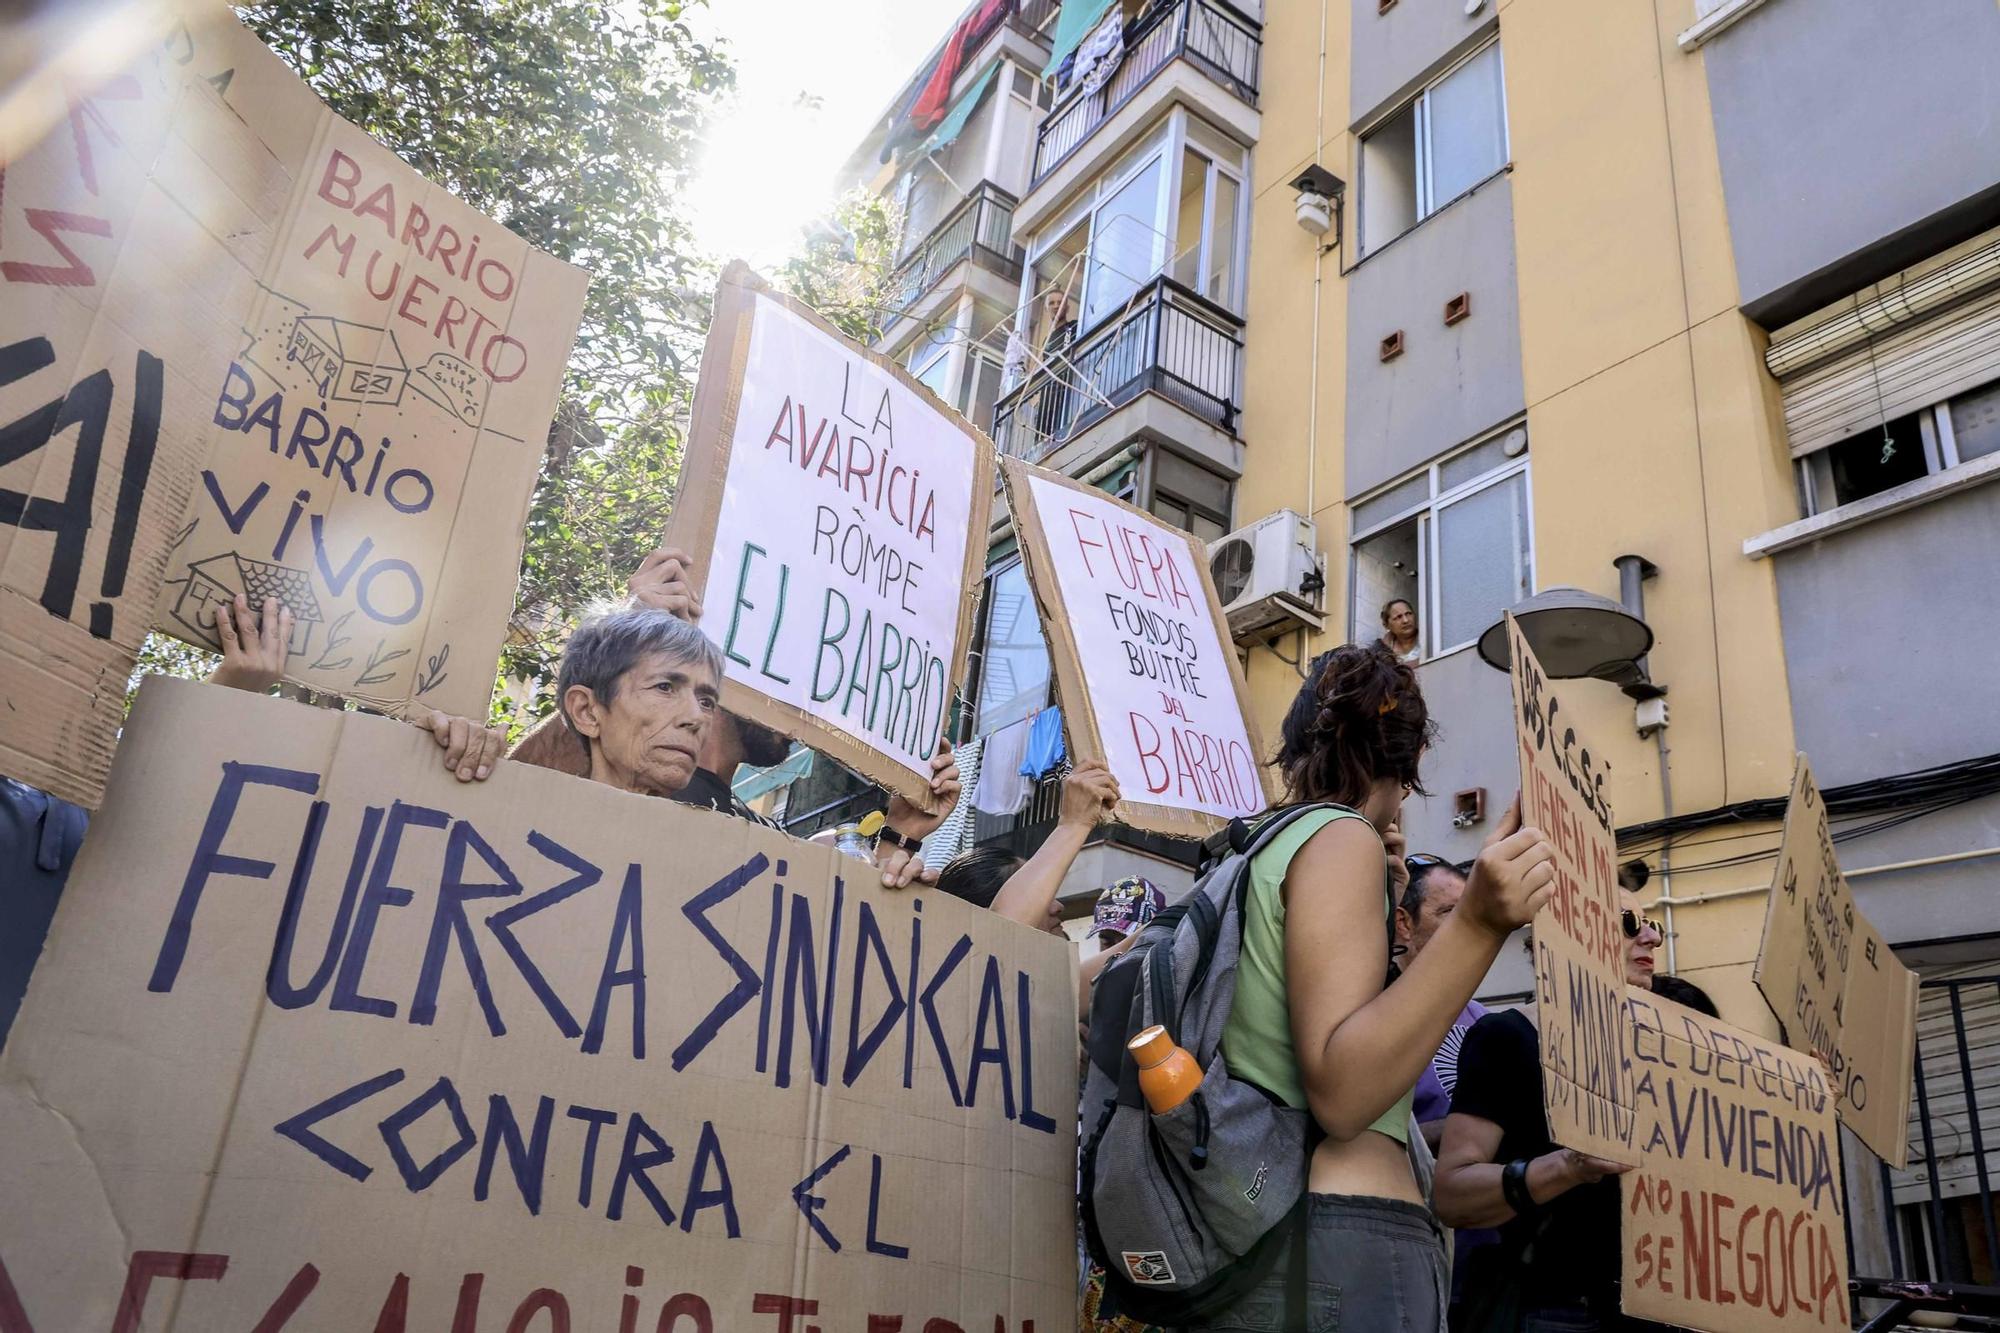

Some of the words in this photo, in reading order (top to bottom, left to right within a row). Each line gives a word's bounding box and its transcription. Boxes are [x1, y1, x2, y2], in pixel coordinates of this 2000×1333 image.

[303, 223, 527, 383] MUERTO
[841, 361, 893, 449] LA
[722, 540, 791, 684] EL
[1069, 508, 1198, 617] FUERA
[1105, 592, 1198, 662] FONDOS
[1158, 690, 1194, 724] DEL
[1129, 711, 1258, 813] BARRIO
[1523, 735, 1588, 883] TIENEN
[148, 760, 646, 1060] FUERZA
[1539, 940, 1558, 1009] EN
[1627, 997, 1677, 1069] EL
[1681, 1015, 1827, 1115] DERECHO
[1636, 1069, 1658, 1107] A
[273, 1068, 742, 1239] CONTRA
[791, 1144, 909, 1259] EL
[1630, 1174, 1673, 1217] NO
[1666, 1077, 1841, 1216] VIVIENDA
[1634, 1232, 1674, 1294] SE
